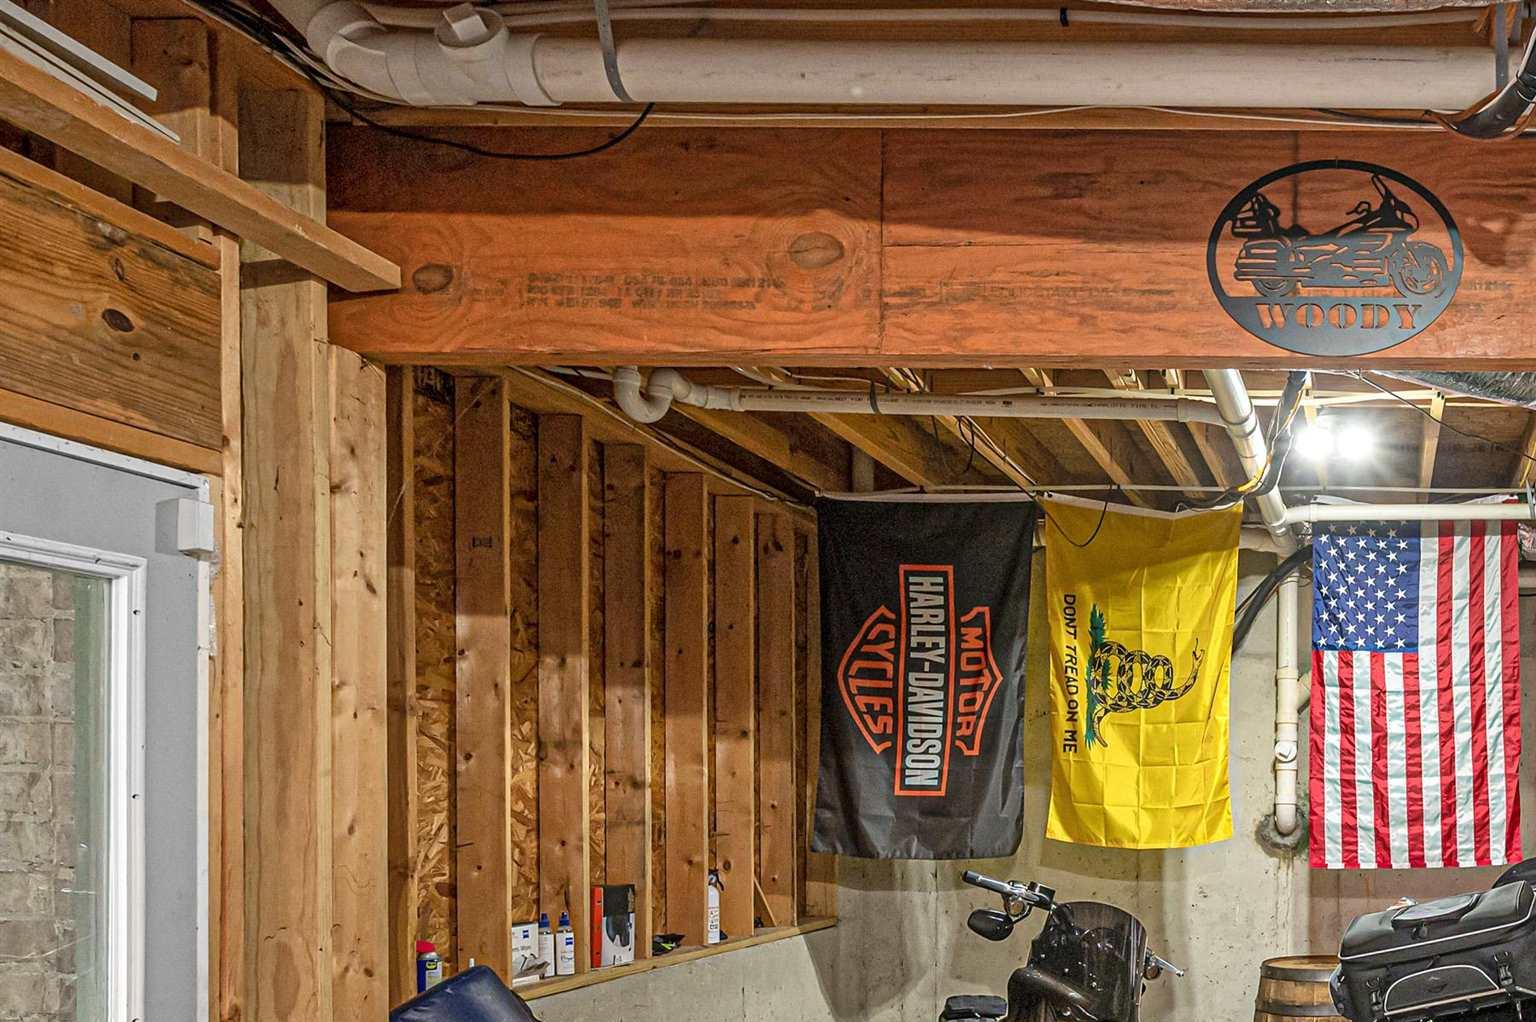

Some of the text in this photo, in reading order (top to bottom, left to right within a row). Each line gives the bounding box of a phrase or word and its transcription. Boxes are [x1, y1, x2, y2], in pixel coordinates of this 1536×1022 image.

[1255, 303, 1423, 330] WOODY
[848, 622, 897, 735] CYCLES
[904, 575, 947, 787] HARLEY-DAVIDSON
[955, 626, 991, 738] MOTOR
[1063, 594, 1079, 753] DONT TREAD ON ME
